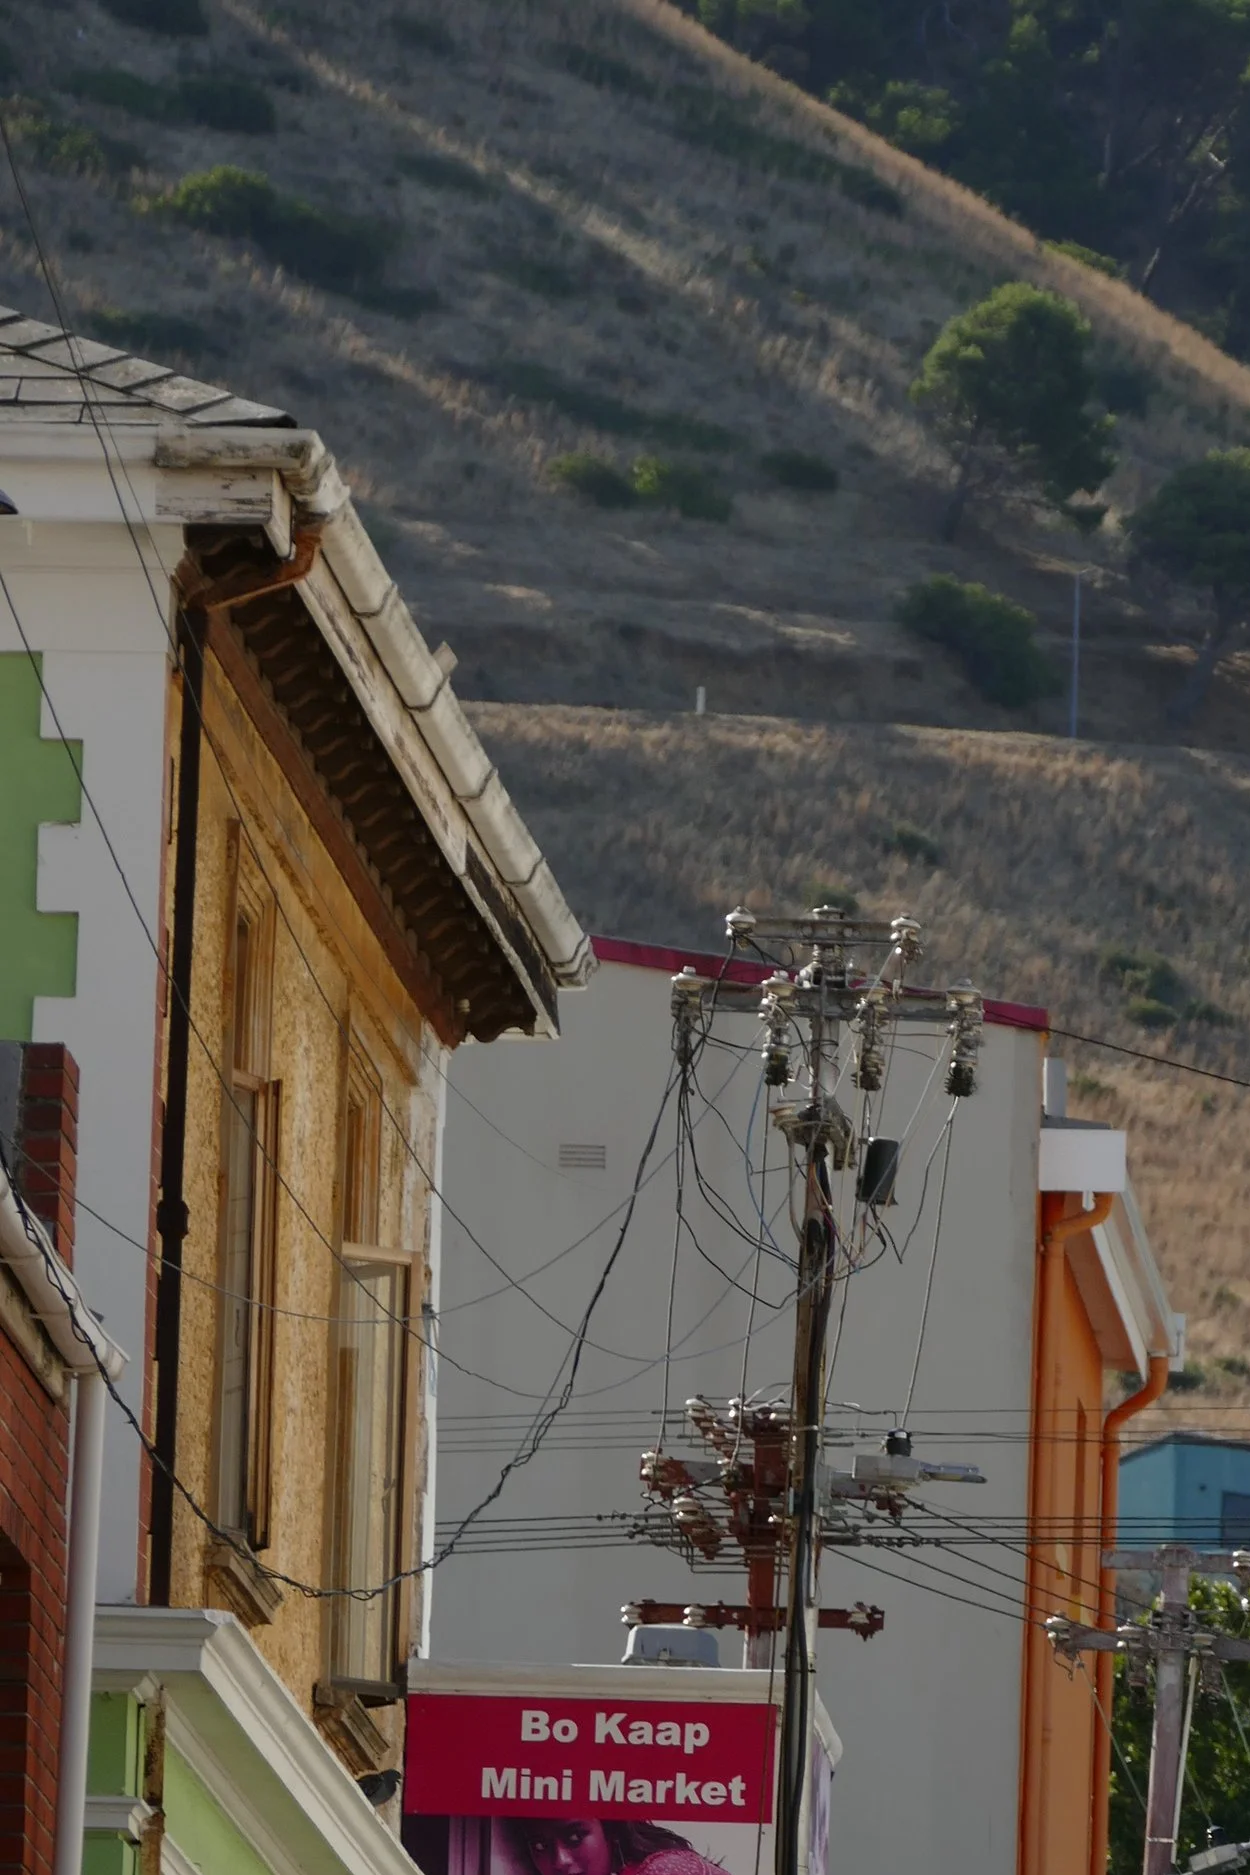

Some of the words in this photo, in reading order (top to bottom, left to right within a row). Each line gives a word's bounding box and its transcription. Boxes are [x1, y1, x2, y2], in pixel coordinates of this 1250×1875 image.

[520, 1709, 578, 1744] Bo
[594, 1712, 711, 1754] Kaap
[481, 1766, 573, 1802] Mini
[588, 1769, 746, 1807] Market
